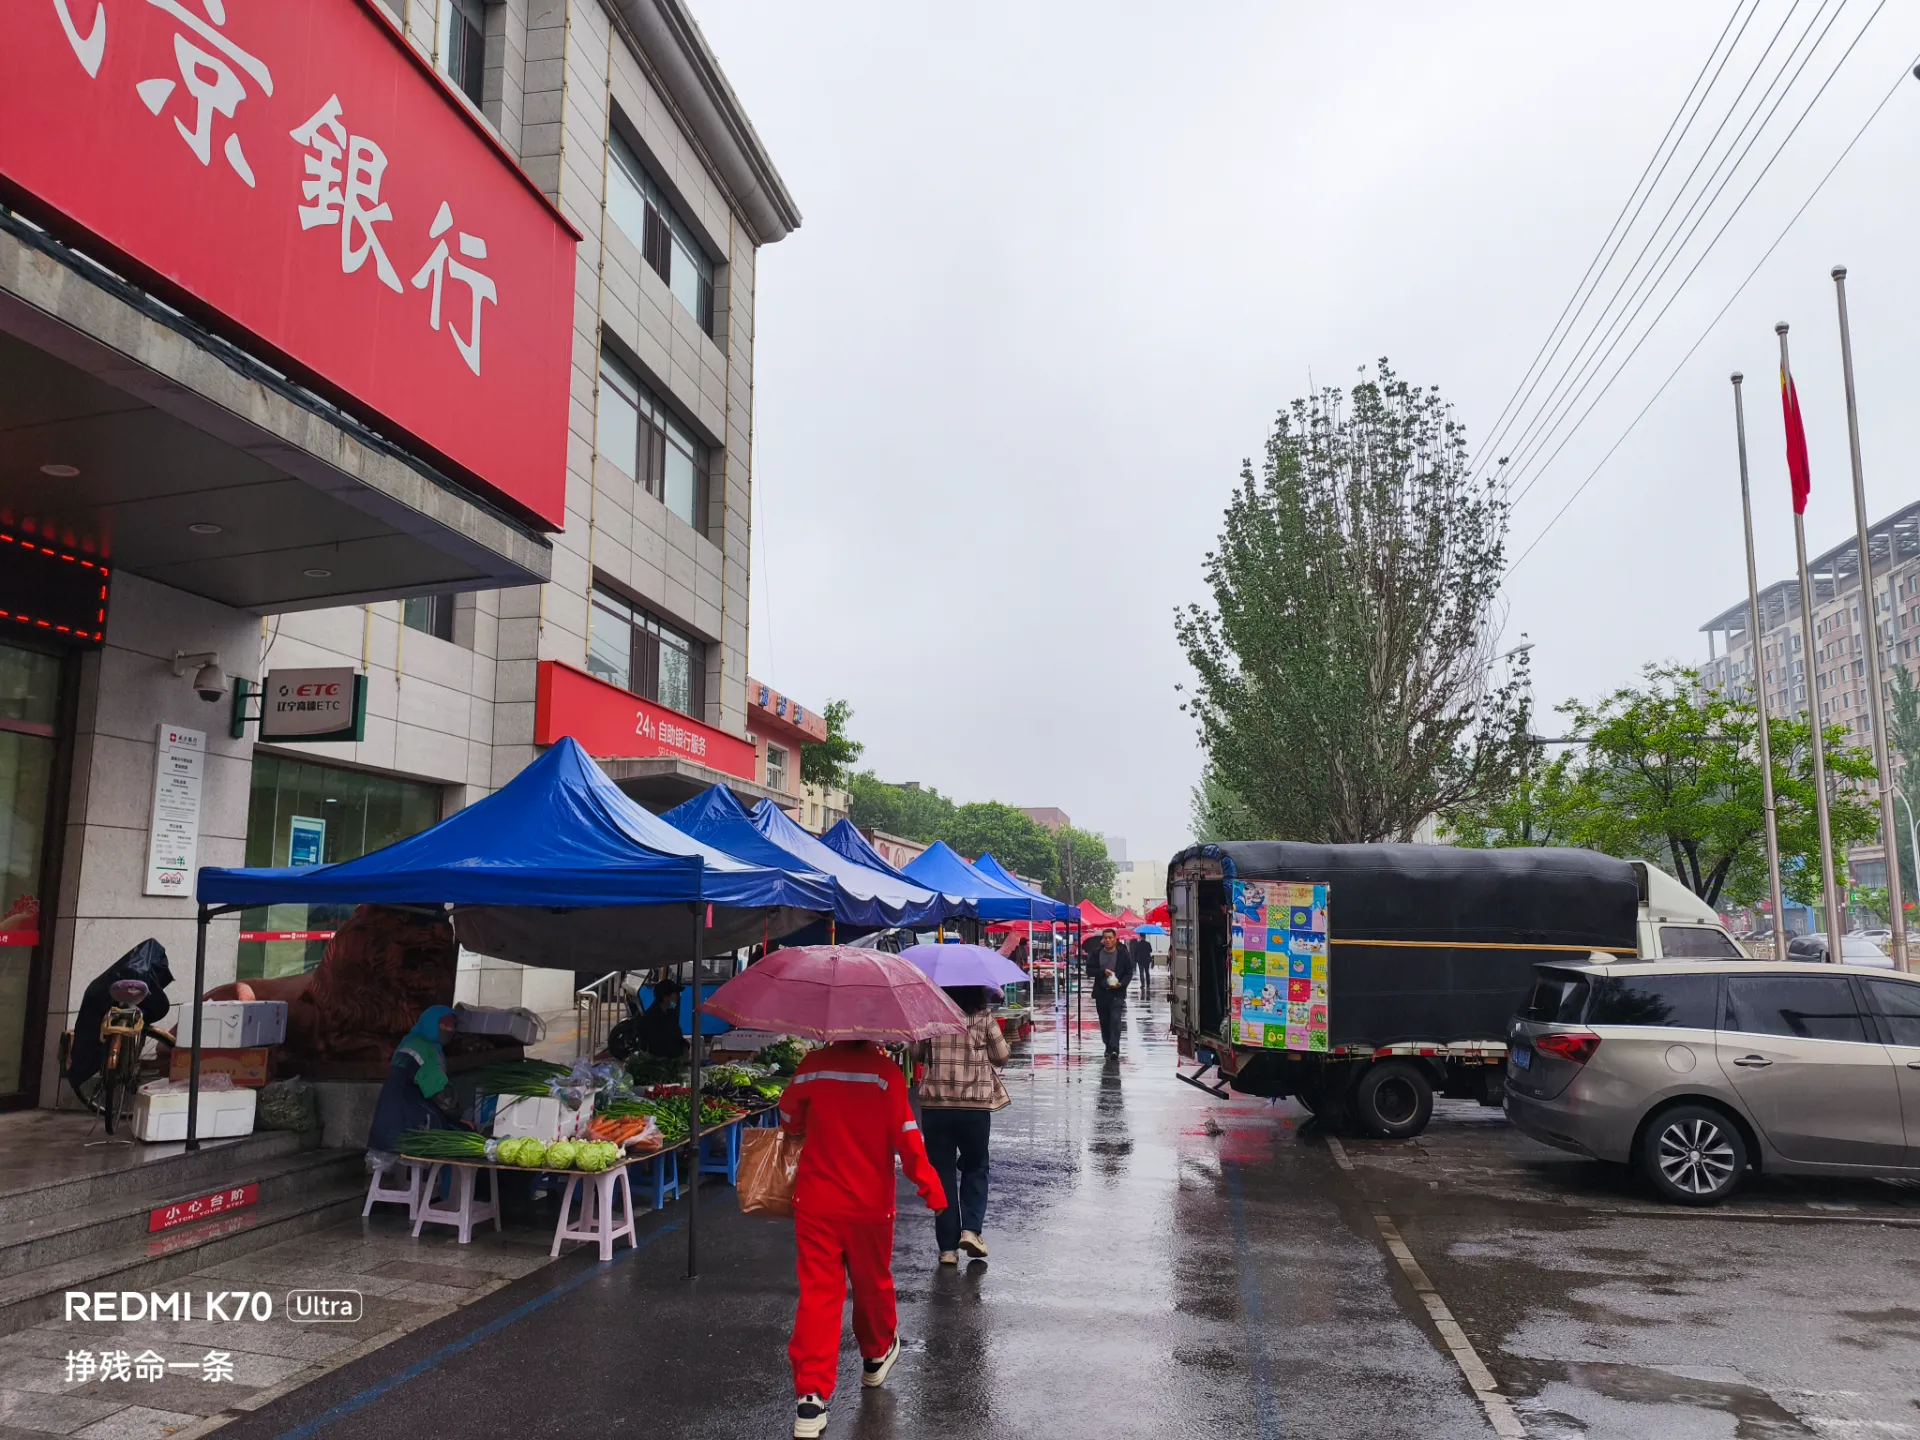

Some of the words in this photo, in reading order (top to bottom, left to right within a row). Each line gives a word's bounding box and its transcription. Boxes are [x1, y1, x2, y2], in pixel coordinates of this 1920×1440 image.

[53, 0, 498, 377] 京銀行
[296, 683, 341, 697] ETC
[635, 711, 656, 740] 24h
[658, 720, 707, 757] 自助银行服务
[164, 1215, 194, 1227] WATCH
[199, 1206, 221, 1216] YOUR
[226, 1200, 245, 1209] STEP
[165, 1188, 245, 1220] 小心台阶
